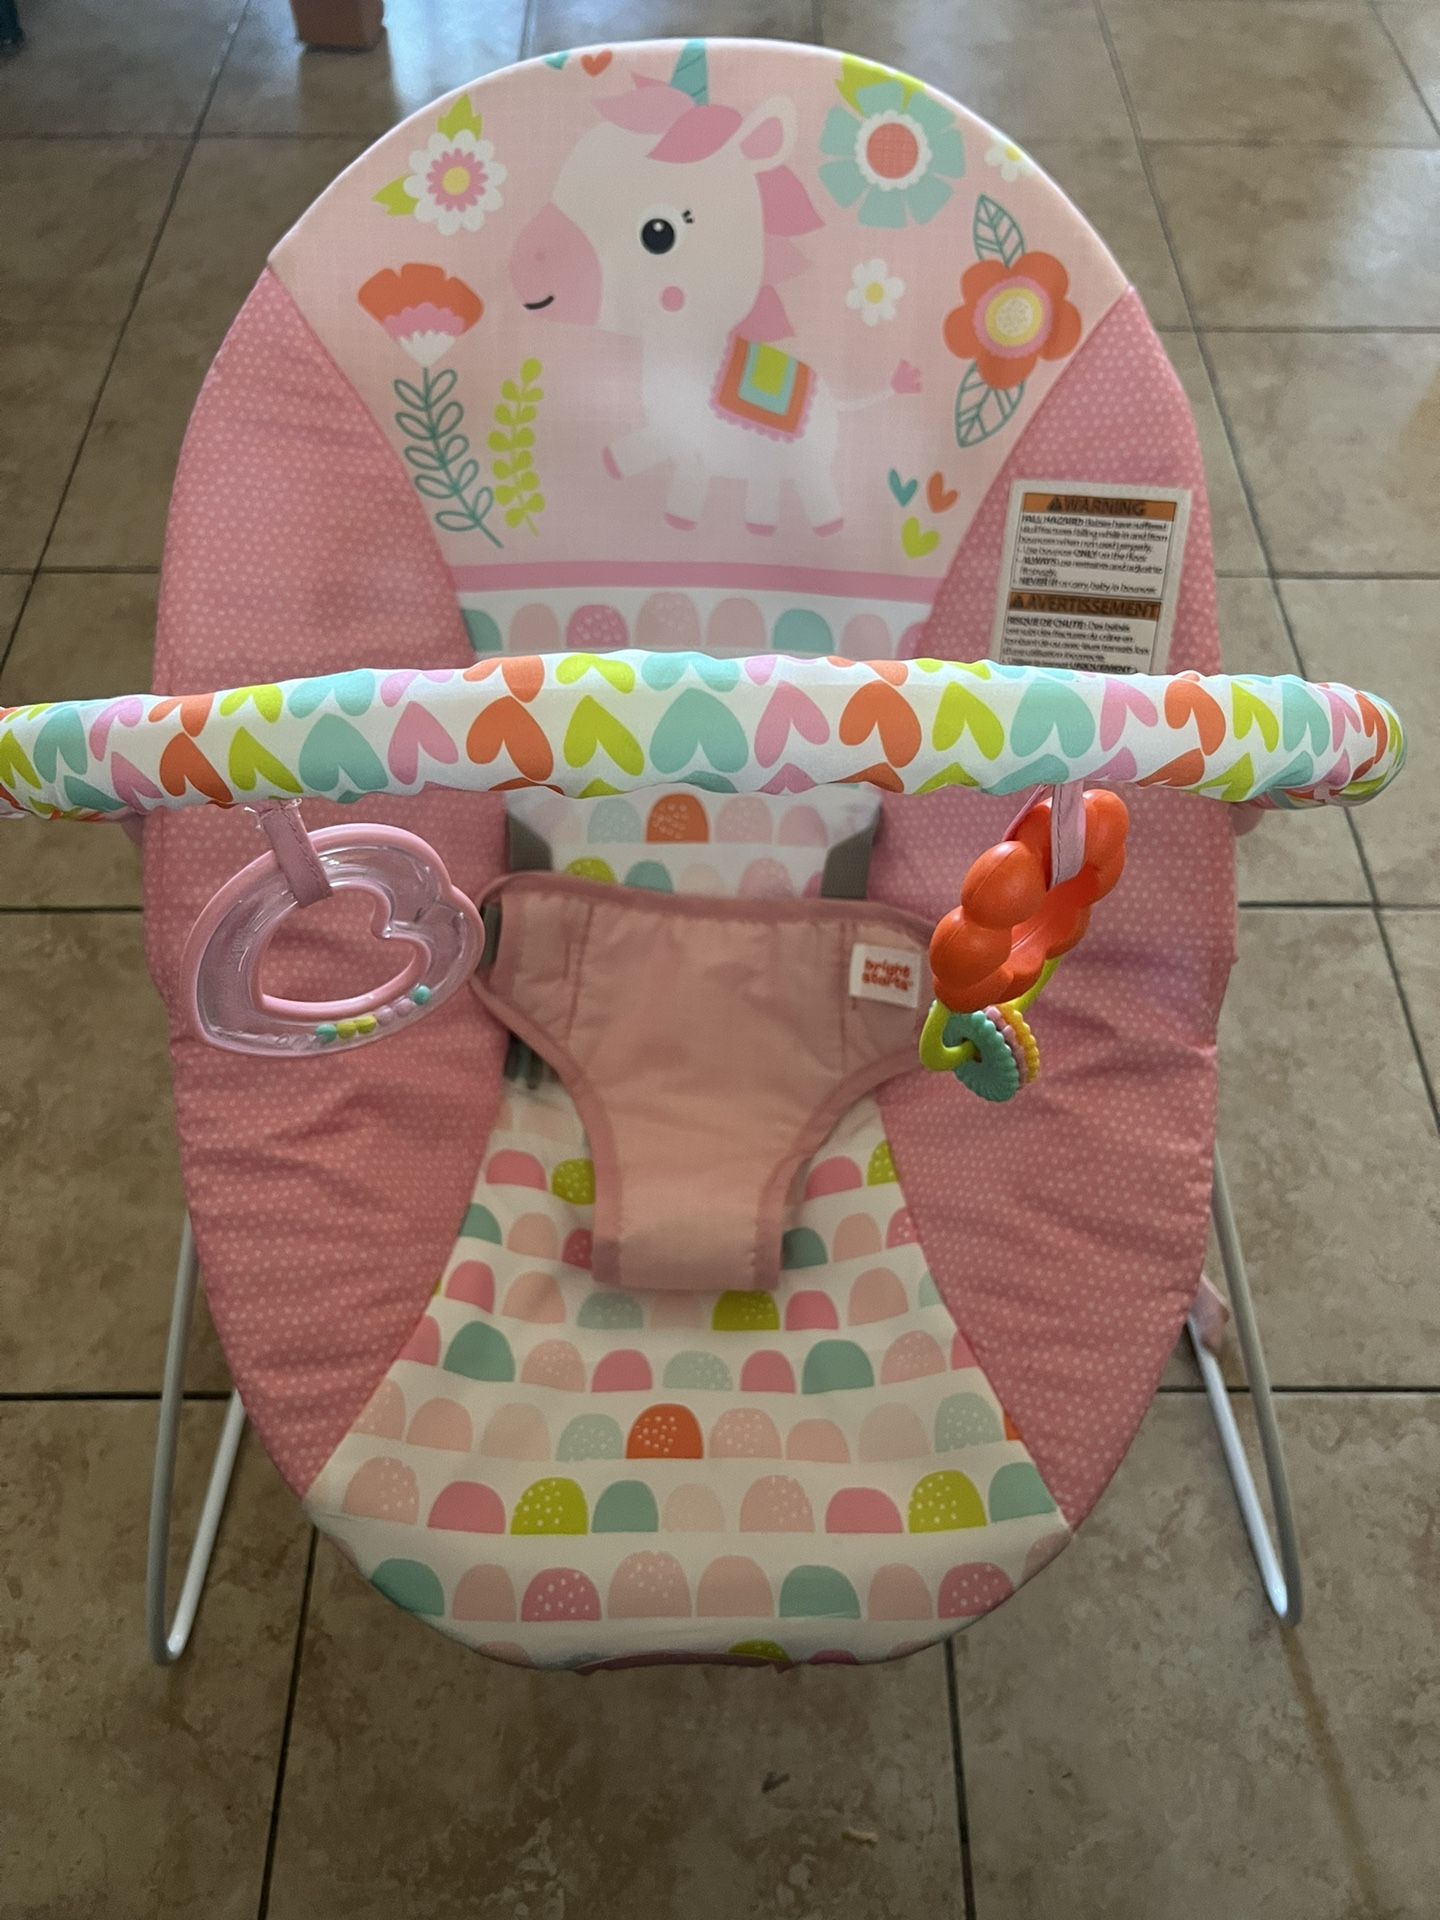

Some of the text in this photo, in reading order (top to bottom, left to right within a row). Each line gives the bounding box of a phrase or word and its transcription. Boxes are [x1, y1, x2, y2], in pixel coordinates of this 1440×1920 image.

[1062, 496, 1146, 515] WARNING
[1027, 593, 1159, 618] AVERTISSEMENT
[865, 958, 910, 979] bright
